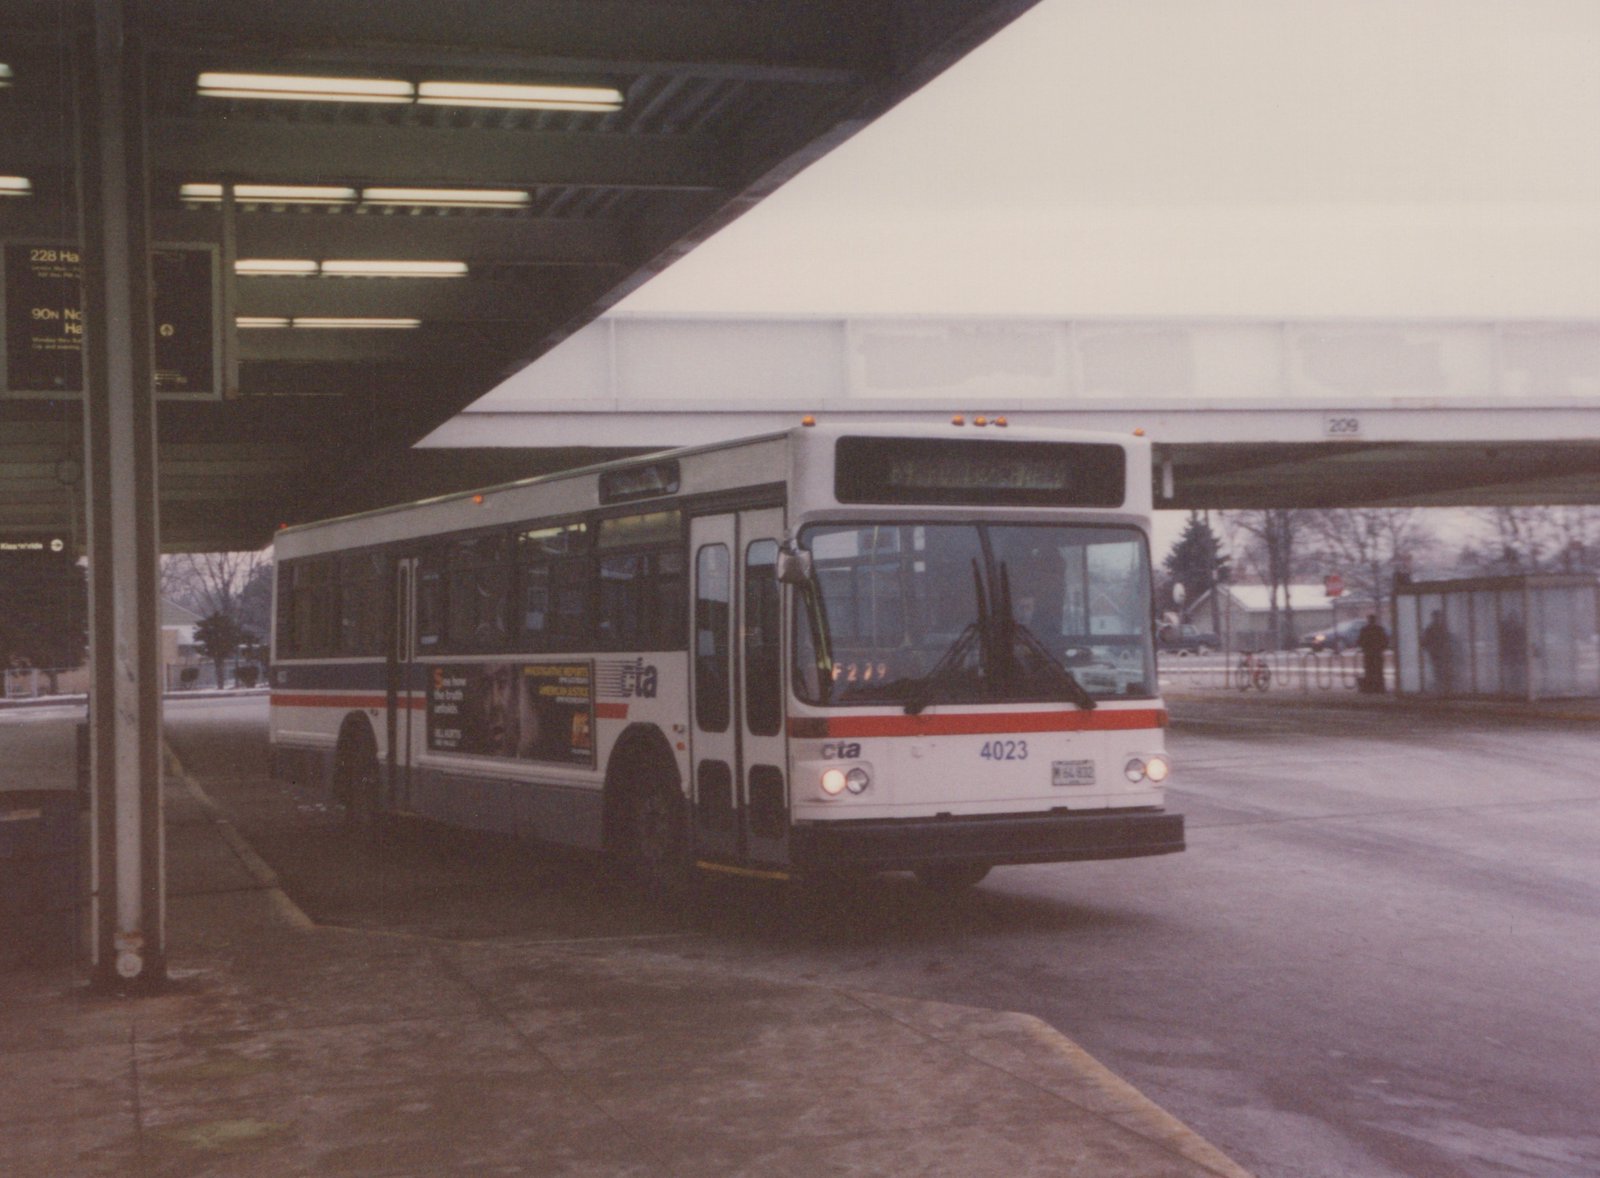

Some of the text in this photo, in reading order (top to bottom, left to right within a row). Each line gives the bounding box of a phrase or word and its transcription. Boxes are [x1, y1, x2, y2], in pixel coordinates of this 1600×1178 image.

[31, 249, 57, 261] 228
[620, 657, 658, 698] cta
[822, 741, 861, 760] cta
[980, 740, 1029, 761] 4023
